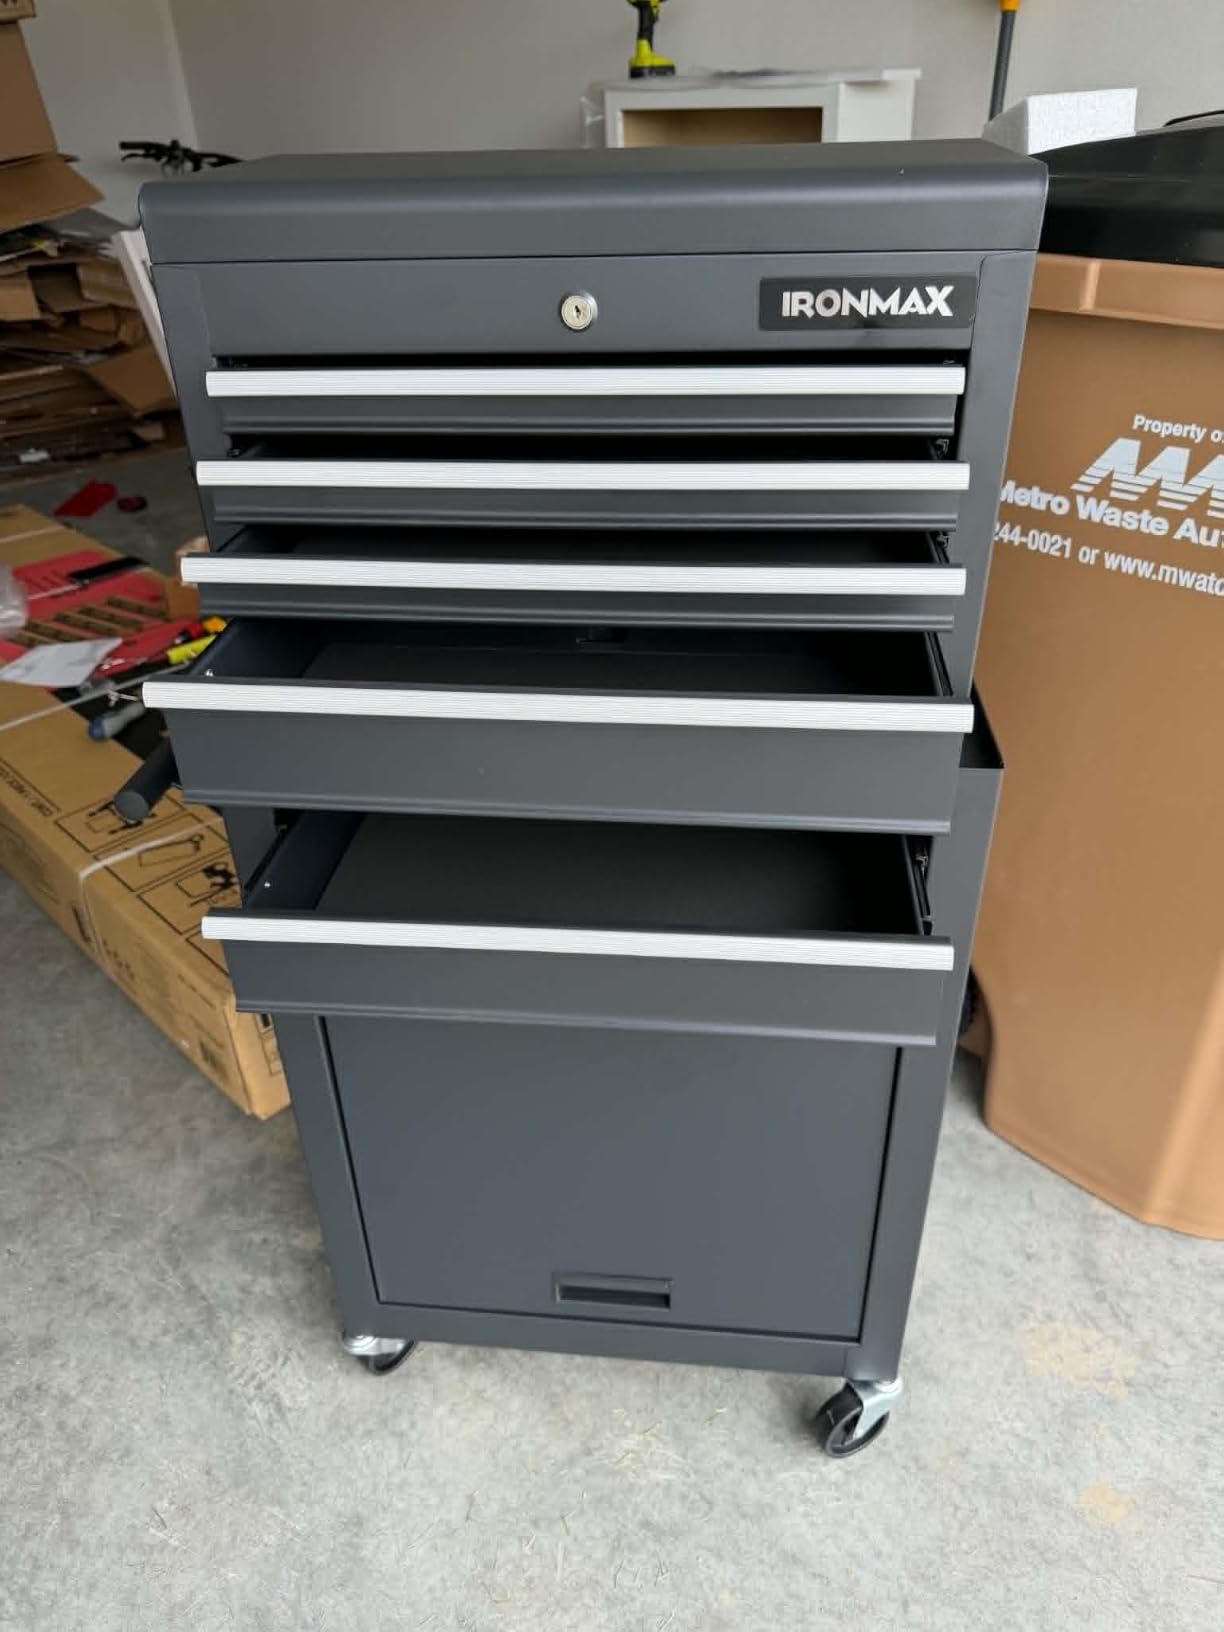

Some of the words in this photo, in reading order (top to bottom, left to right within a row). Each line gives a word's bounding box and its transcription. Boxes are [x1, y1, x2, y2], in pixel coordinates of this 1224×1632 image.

[782, 285, 954, 318] IRONMAX
[1132, 414, 1207, 443] Property
[1210, 431, 1224, 444] o
[1076, 495, 1170, 536] Waste
[1078, 546, 1100, 565] or
